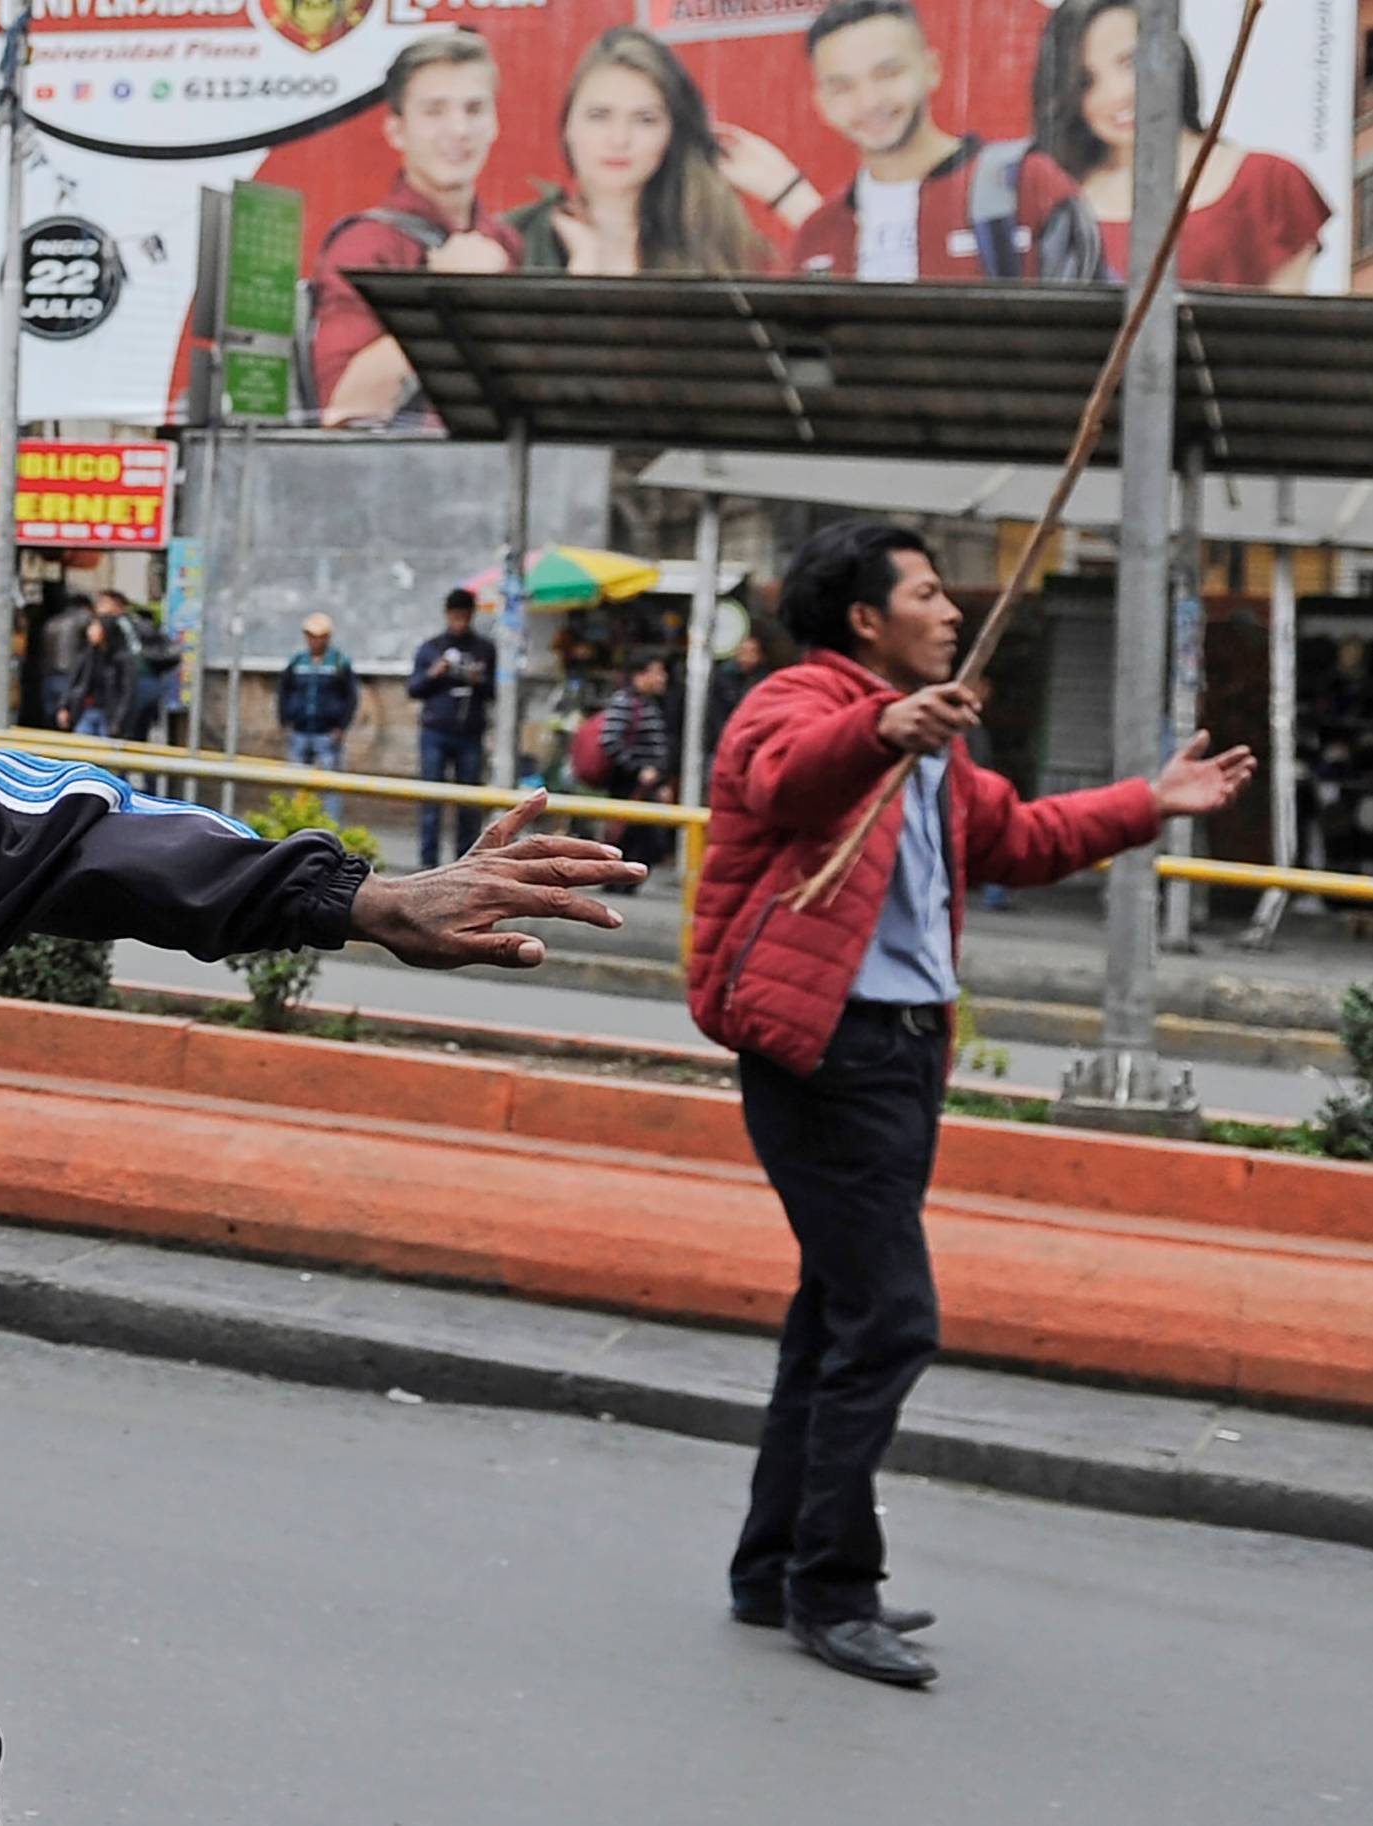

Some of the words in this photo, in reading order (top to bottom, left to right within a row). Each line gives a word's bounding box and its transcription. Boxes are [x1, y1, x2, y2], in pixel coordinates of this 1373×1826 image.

[183, 77, 337, 99] 61124000
[25, 258, 100, 295] 22
[19, 297, 104, 319] JULIO
